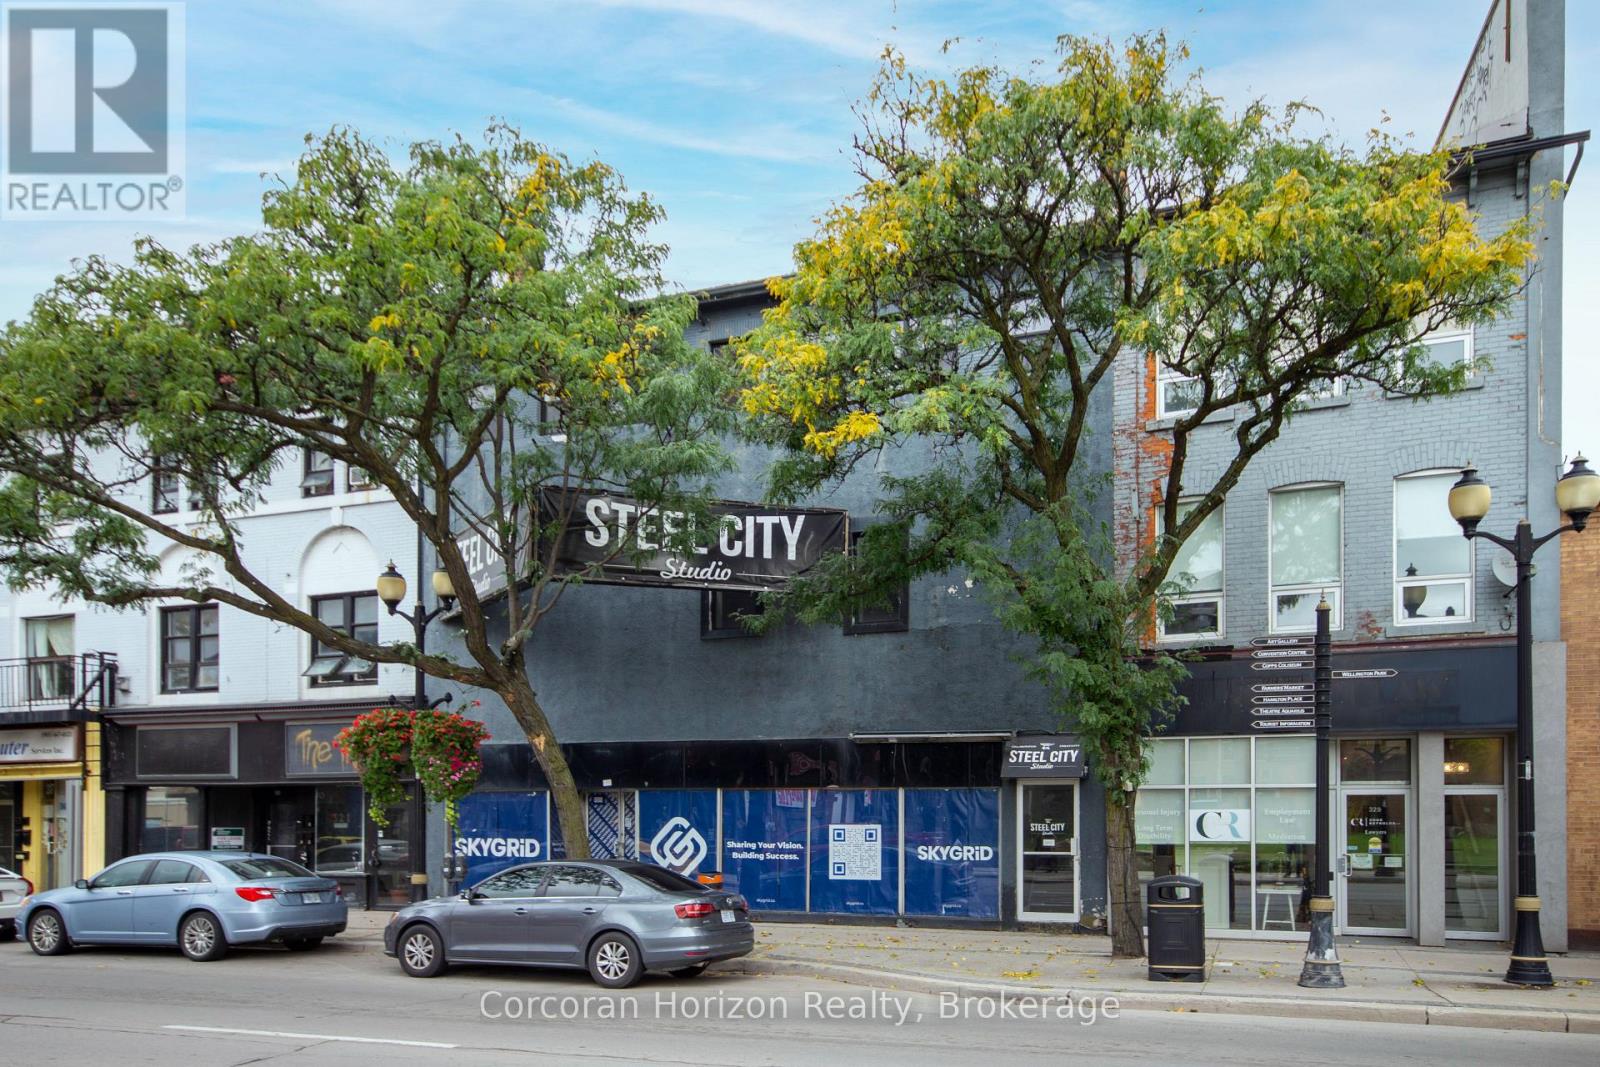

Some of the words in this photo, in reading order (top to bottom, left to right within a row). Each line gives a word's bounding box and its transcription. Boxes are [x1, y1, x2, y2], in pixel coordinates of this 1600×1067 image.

[719, 514, 806, 561] CITY
[660, 558, 732, 581] Studio
[1008, 749, 1047, 763] STEEL
[1049, 749, 1079, 763] CITY
[1030, 823, 1049, 832] STEEL
[1050, 823, 1065, 832] CITY
[1196, 811, 1243, 839] CR
[726, 840, 757, 850] Sharing
[757, 841, 776, 849] Your
[776, 841, 804, 849] Vision.
[731, 851, 765, 861] Building
[765, 852, 800, 860] Success.
